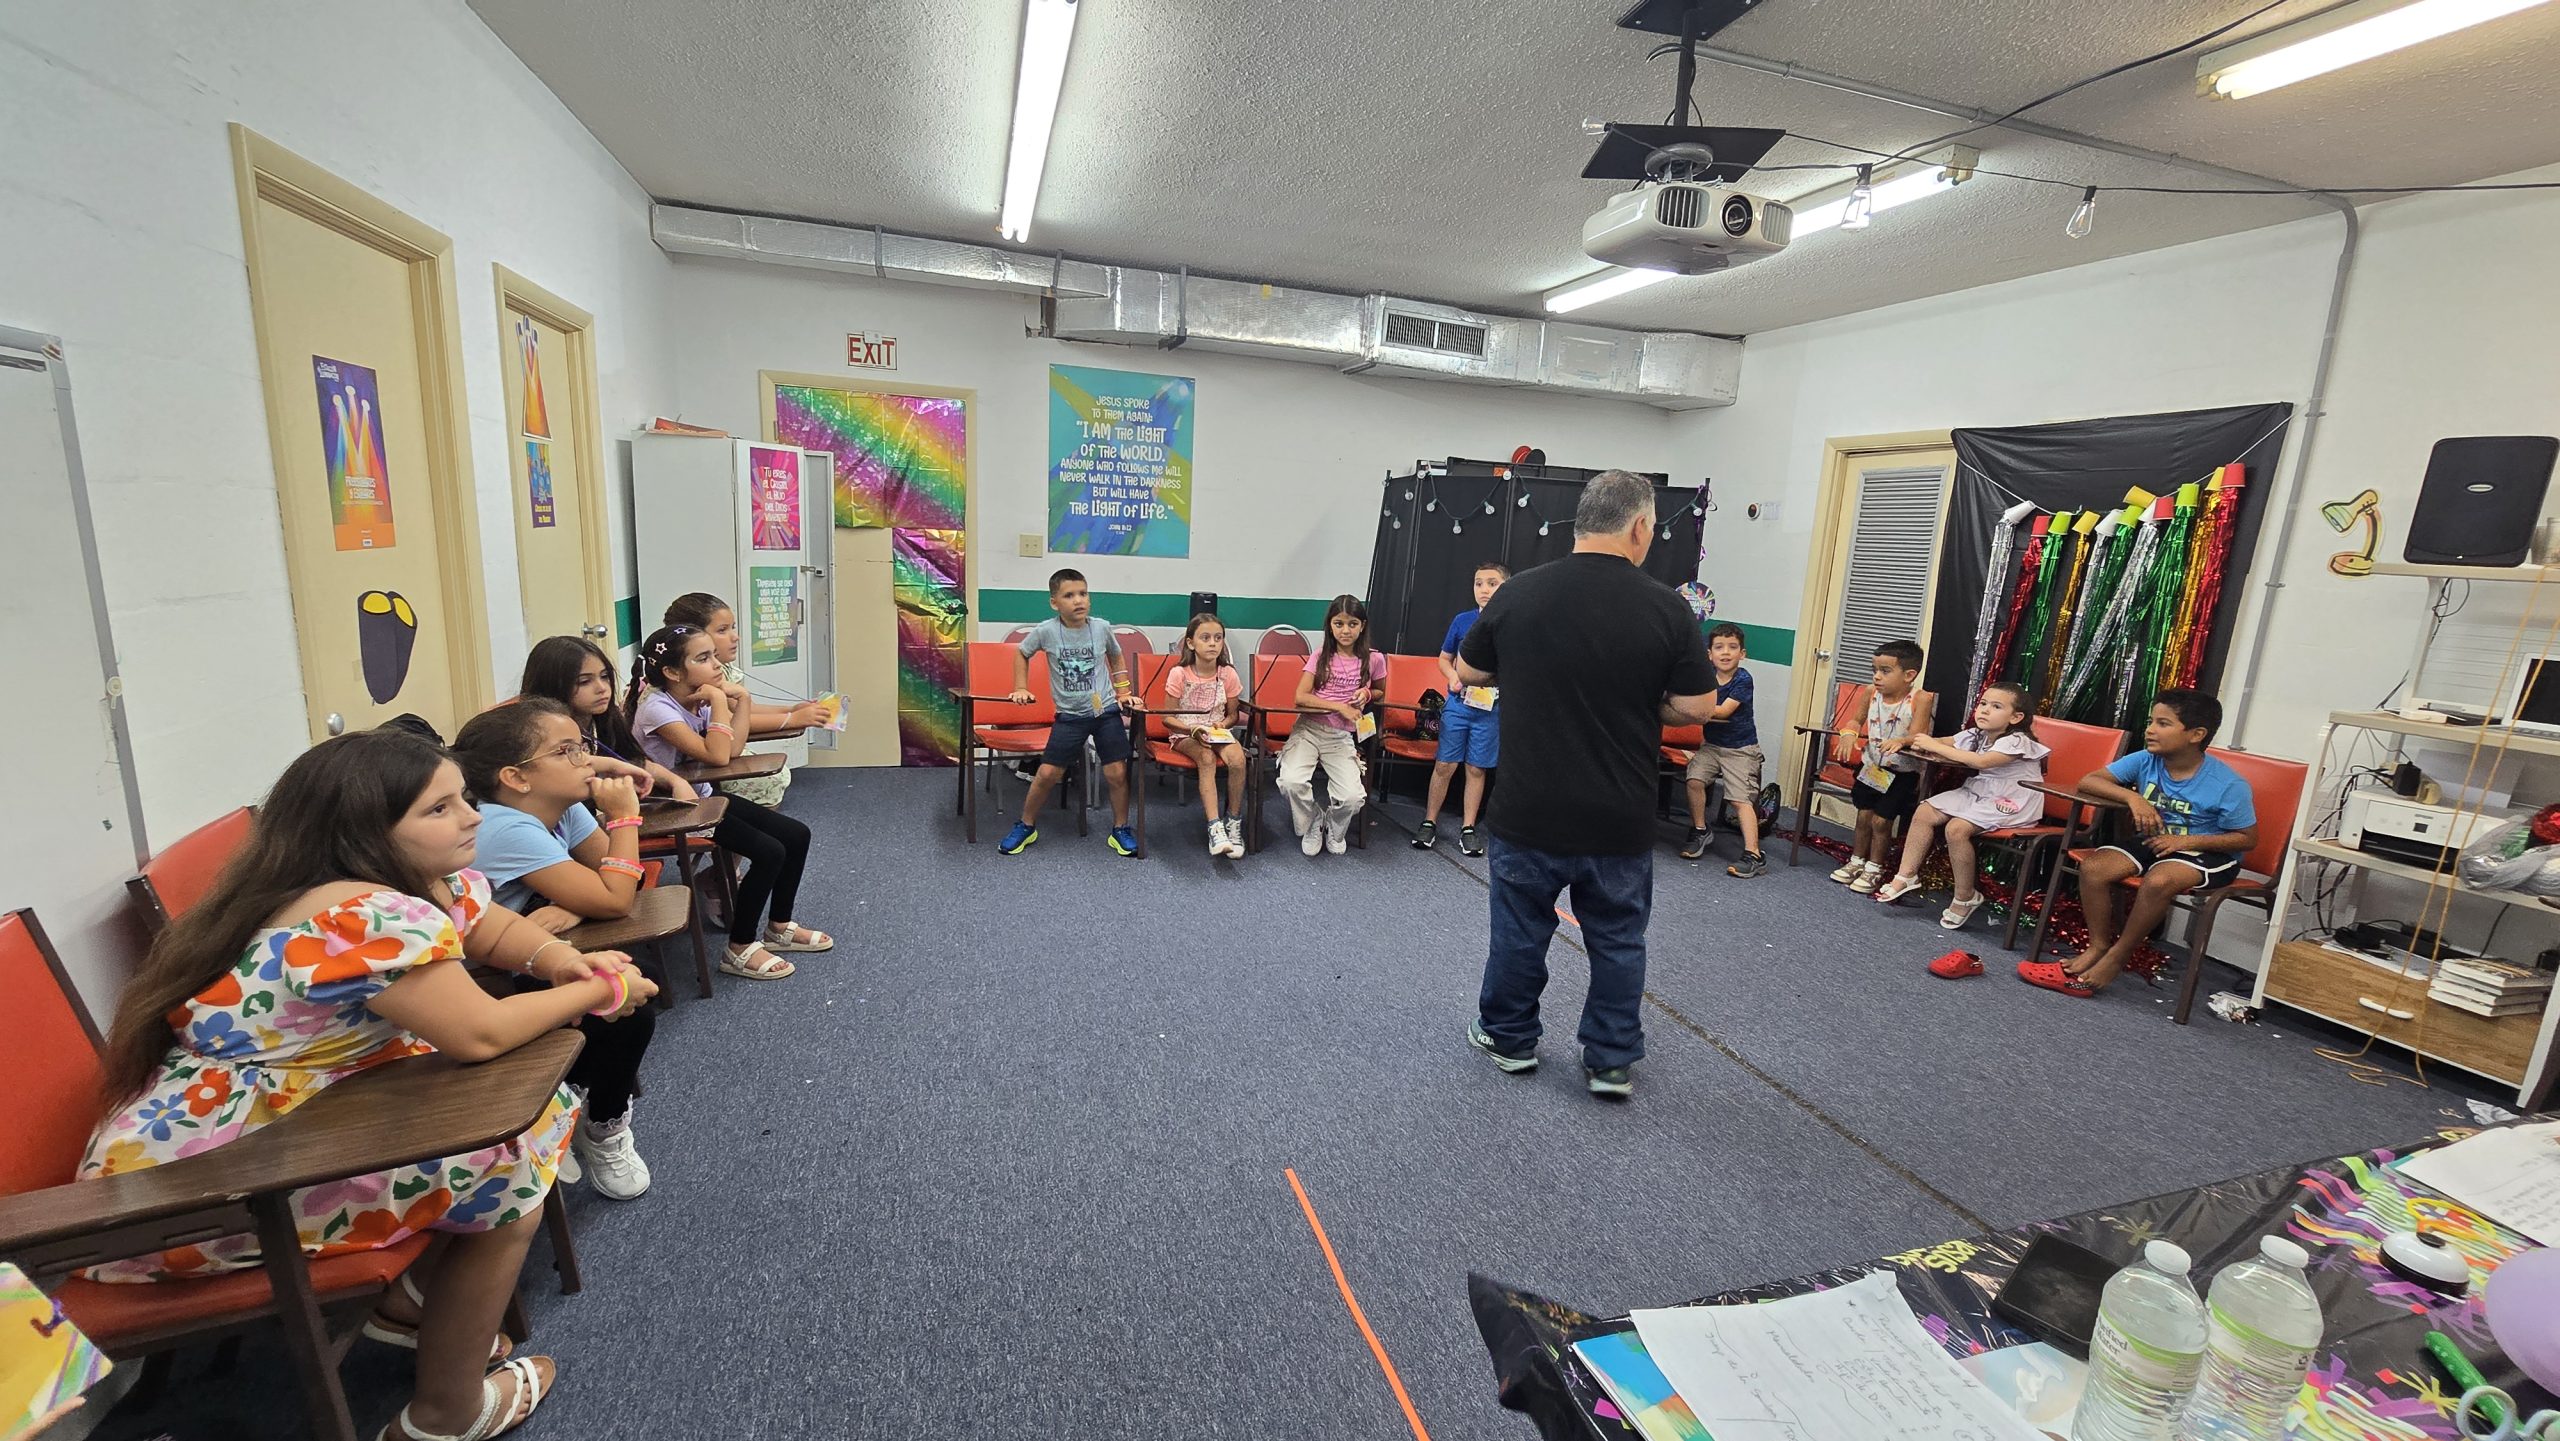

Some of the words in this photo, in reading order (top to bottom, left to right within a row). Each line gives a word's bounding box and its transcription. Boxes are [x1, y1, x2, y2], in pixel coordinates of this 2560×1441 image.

[850, 337, 895, 366] EXIT
[1091, 422, 1111, 440] AM
[1120, 444, 1166, 462] WORLD.
[1096, 461, 1114, 472] WHO
[1112, 475, 1122, 486] IN
[1092, 486, 1109, 497] BUT
[1081, 647, 1094, 657] ON
